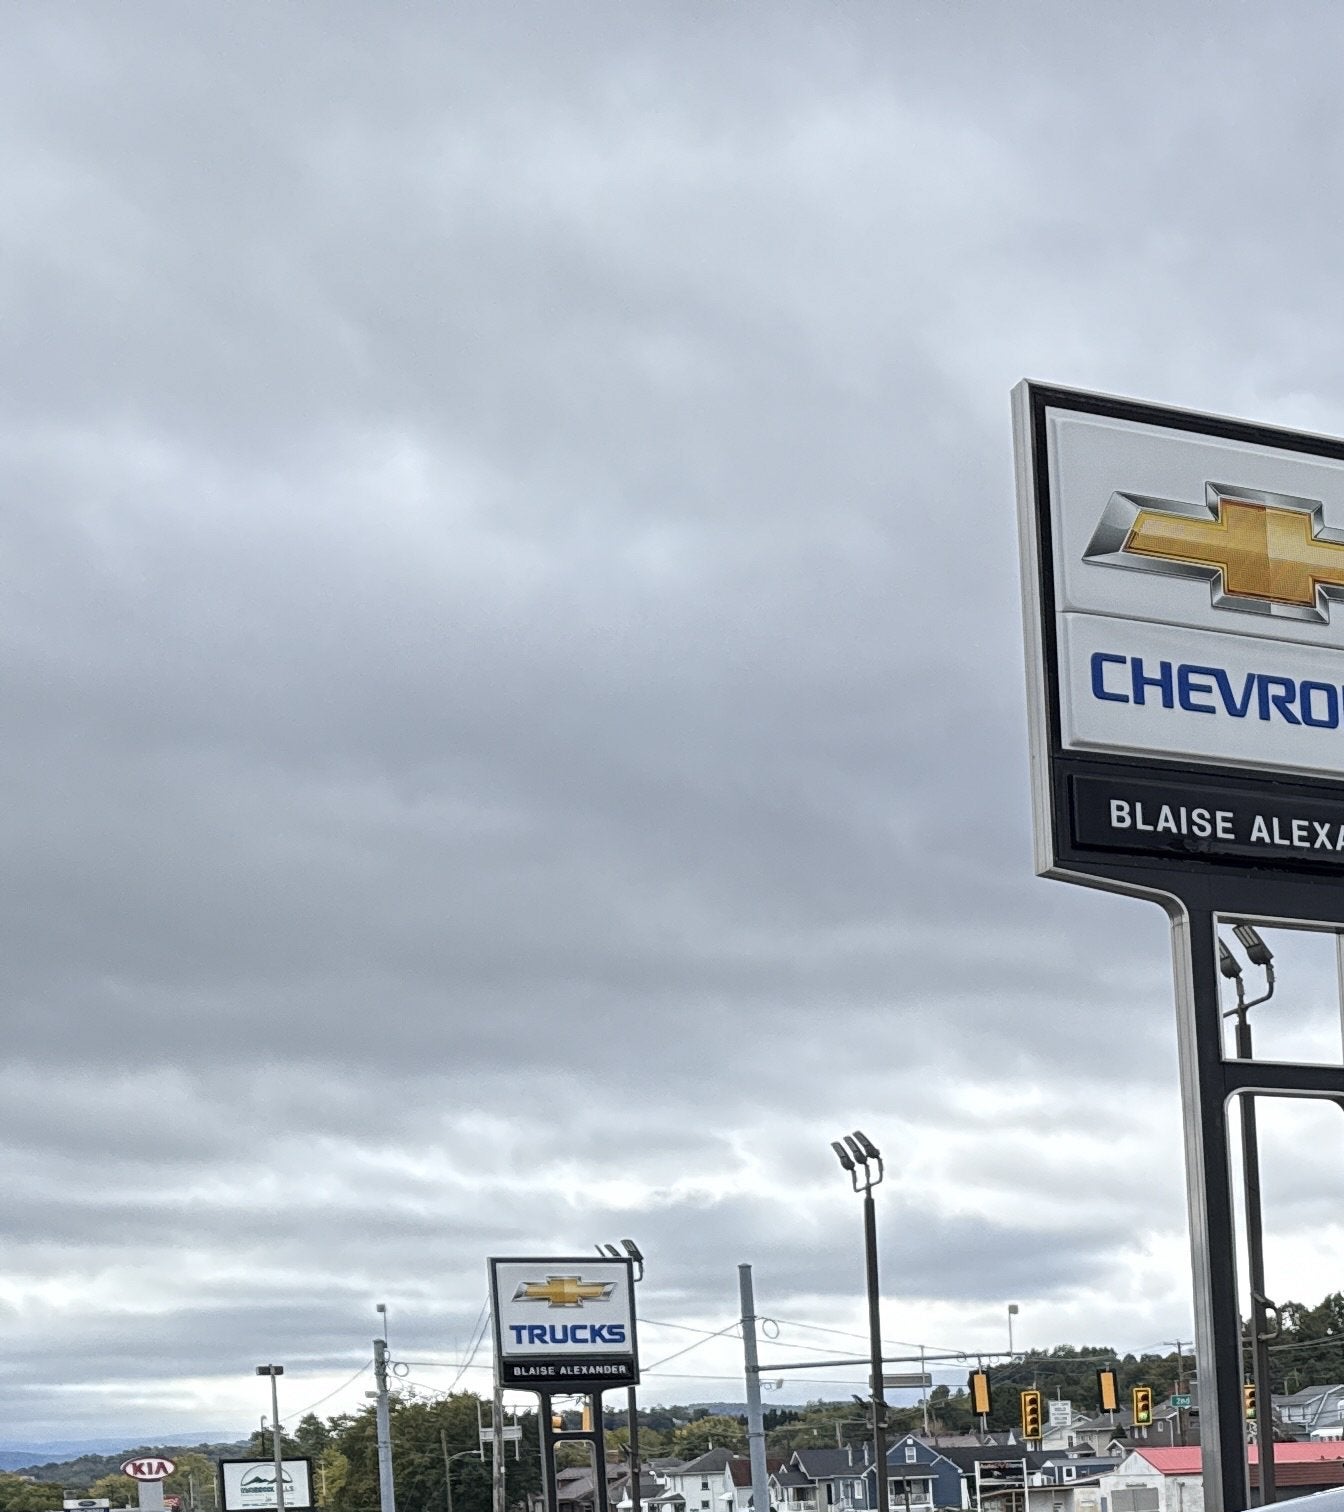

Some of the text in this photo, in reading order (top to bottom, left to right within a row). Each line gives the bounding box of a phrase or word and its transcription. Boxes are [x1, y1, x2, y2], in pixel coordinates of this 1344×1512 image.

[1110, 799, 1236, 840] BLAISE
[509, 1324, 626, 1344] TRUCKS
[513, 1365, 626, 1376] BLAISE ALEXANDER
[131, 1462, 169, 1476] KIA
